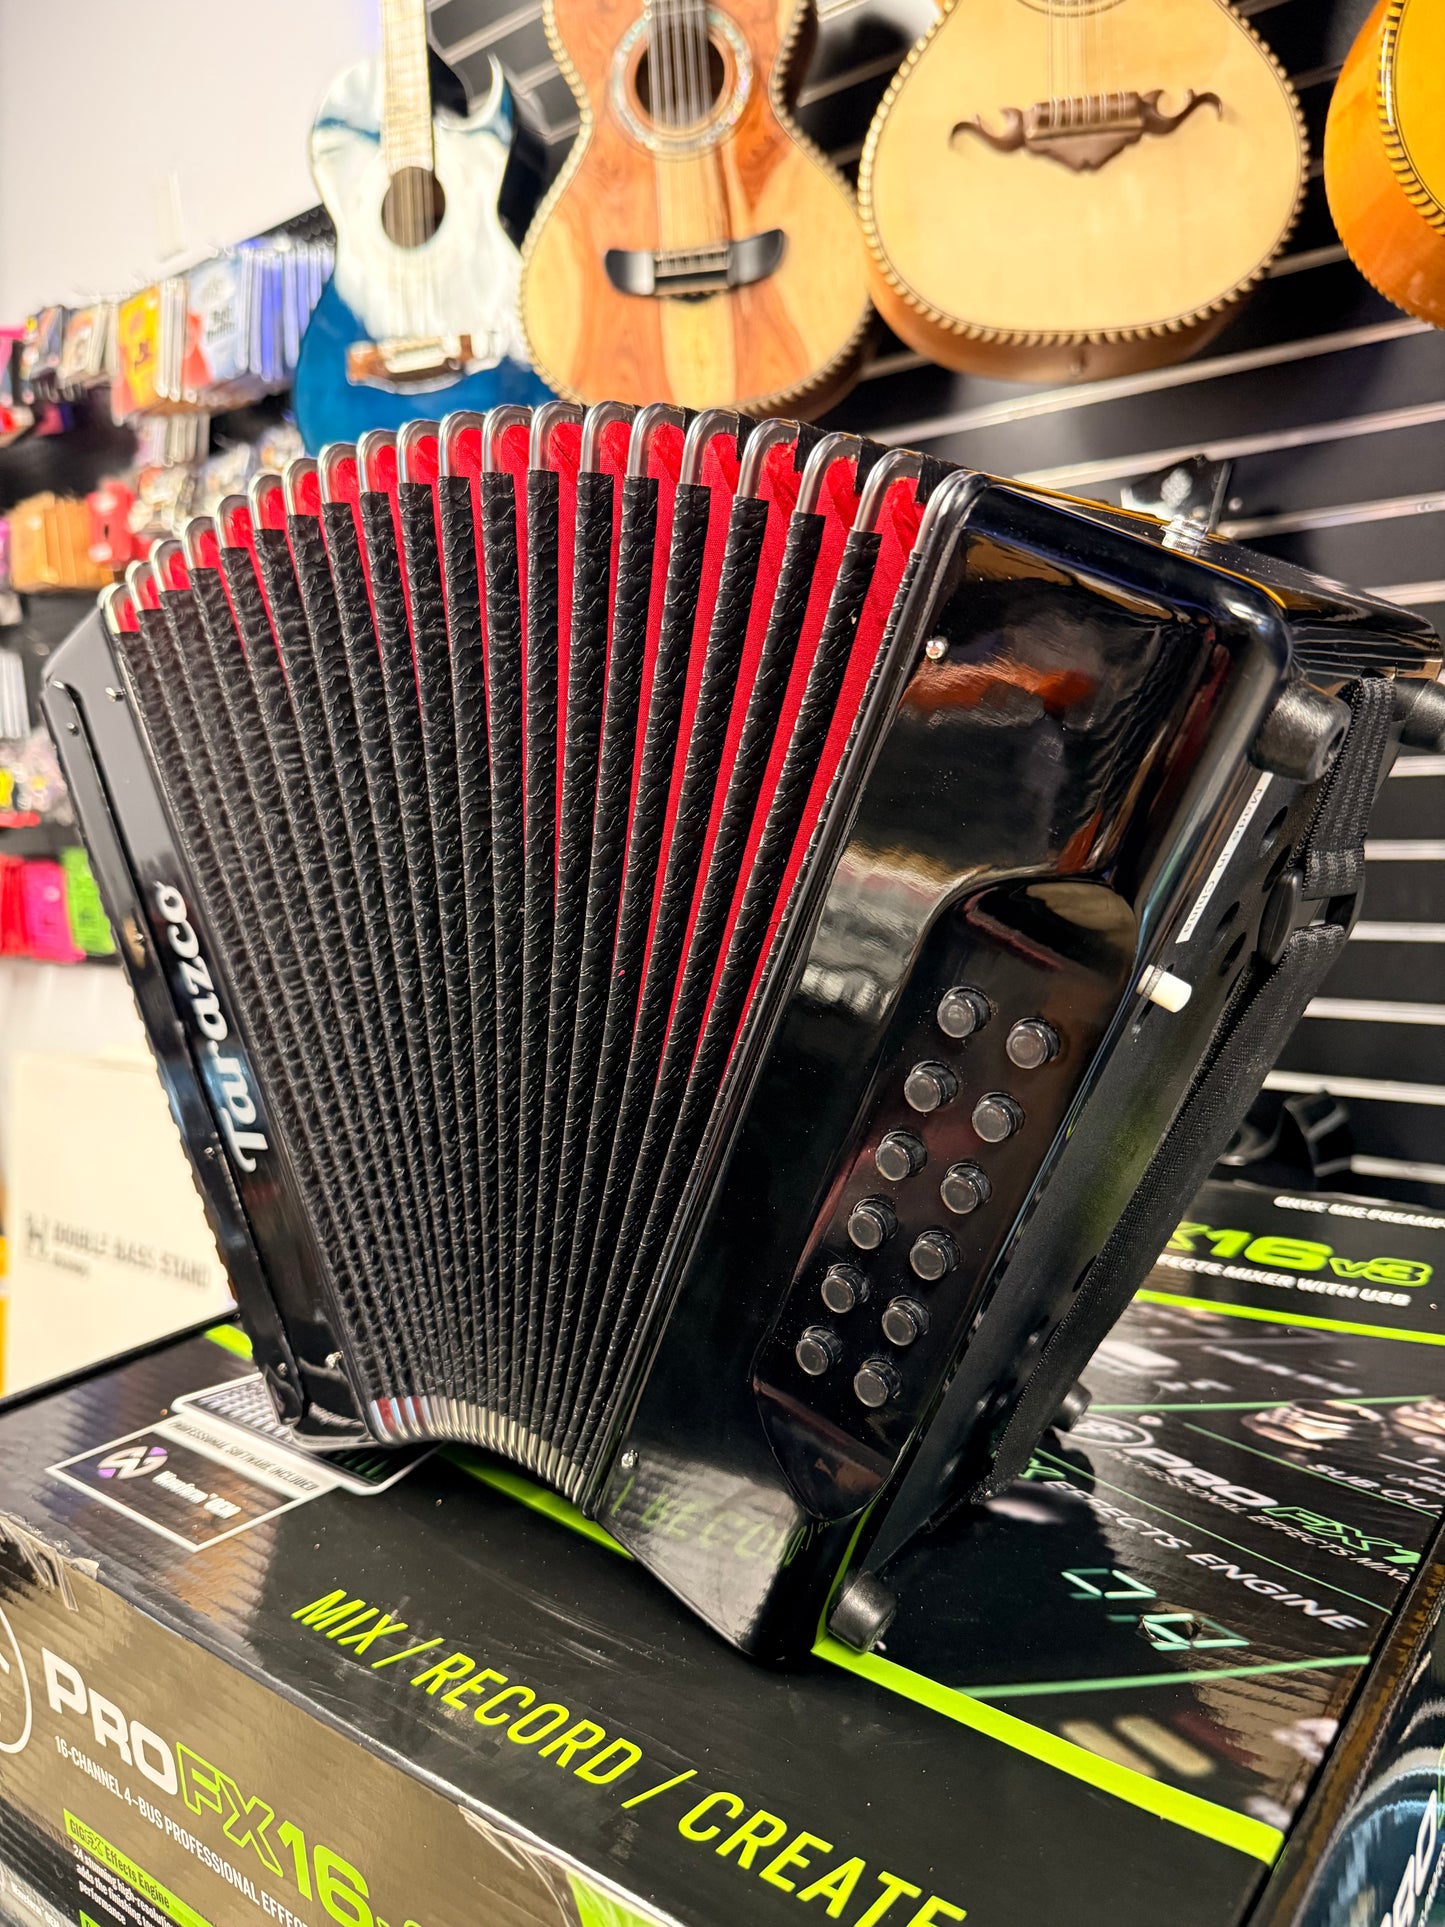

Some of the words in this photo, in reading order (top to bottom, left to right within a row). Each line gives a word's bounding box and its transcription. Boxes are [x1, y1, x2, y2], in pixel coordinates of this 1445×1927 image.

[152, 880, 269, 1173] Tarazco
[1296, 1277, 1360, 1299] WITH
[1306, 1463, 1380, 1488] SUB
[1380, 1489, 1444, 1515] OU
[1184, 1553, 1370, 1631] ENGINE
[291, 1589, 410, 1655] MIX
[410, 1652, 643, 1786] RECORD
[677, 1791, 968, 1927] CREATE
[54, 1735, 124, 1800] 16-CHANNEL
[163, 1815, 261, 1906] PROFESSIONAL
